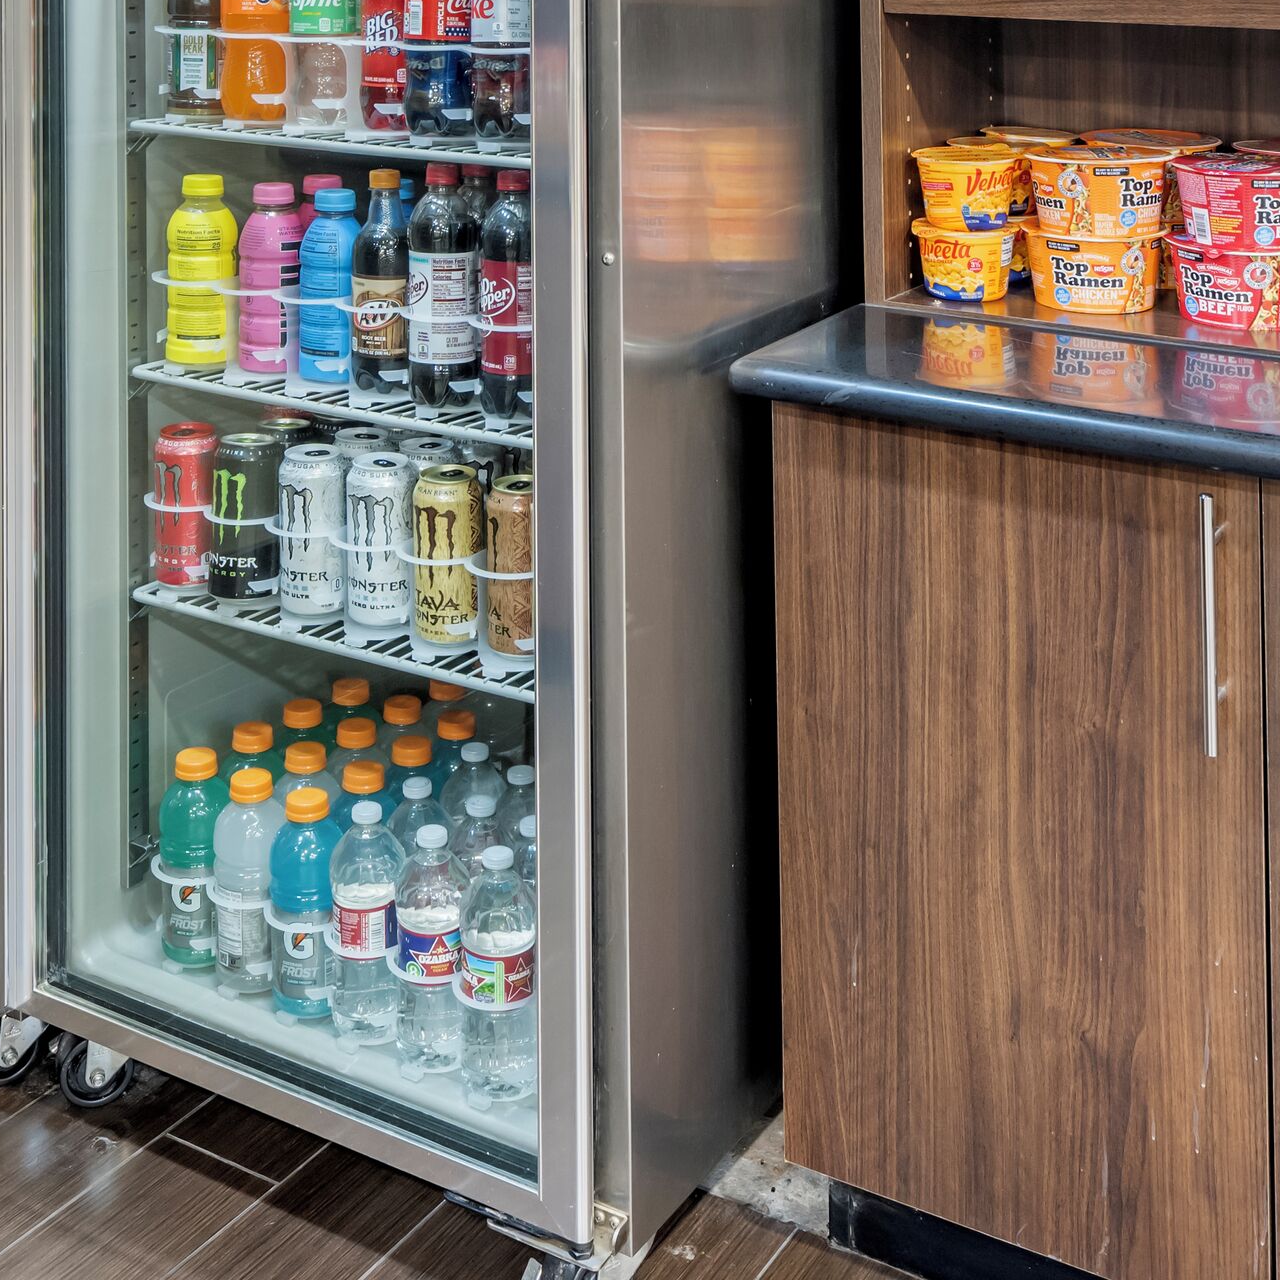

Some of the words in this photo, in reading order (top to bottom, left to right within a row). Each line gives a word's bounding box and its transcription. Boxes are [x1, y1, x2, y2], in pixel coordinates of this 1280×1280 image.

[367, 11, 393, 34] BIG
[437, 0, 445, 36] RECYCLE
[183, 36, 203, 45] GOLD
[183, 45, 203, 53] PEAK
[967, 168, 1013, 196] Velvee
[1121, 178, 1152, 194] Top
[1121, 194, 1162, 207] Rame
[920, 239, 971, 259] lveeta
[1051, 256, 1089, 276] Top
[1207, 265, 1233, 276] ORIGINAL
[1054, 271, 1124, 288] Ramen
[1181, 265, 1212, 287] Top
[482, 278, 496, 293] Dr
[1072, 288, 1117, 299] CHICKEN
[1184, 279, 1250, 303] Ramen
[1198, 299, 1236, 316] BEEF
[1237, 305, 1254, 313] FLAVOR
[205, 553, 258, 569] ONSTER
[209, 568, 246, 578] NERGY
[171, 881, 201, 913] G
[170, 919, 206, 931] FROST
[283, 923, 315, 960] G
[418, 951, 459, 964] OZARKA
[281, 965, 320, 978] FROST
